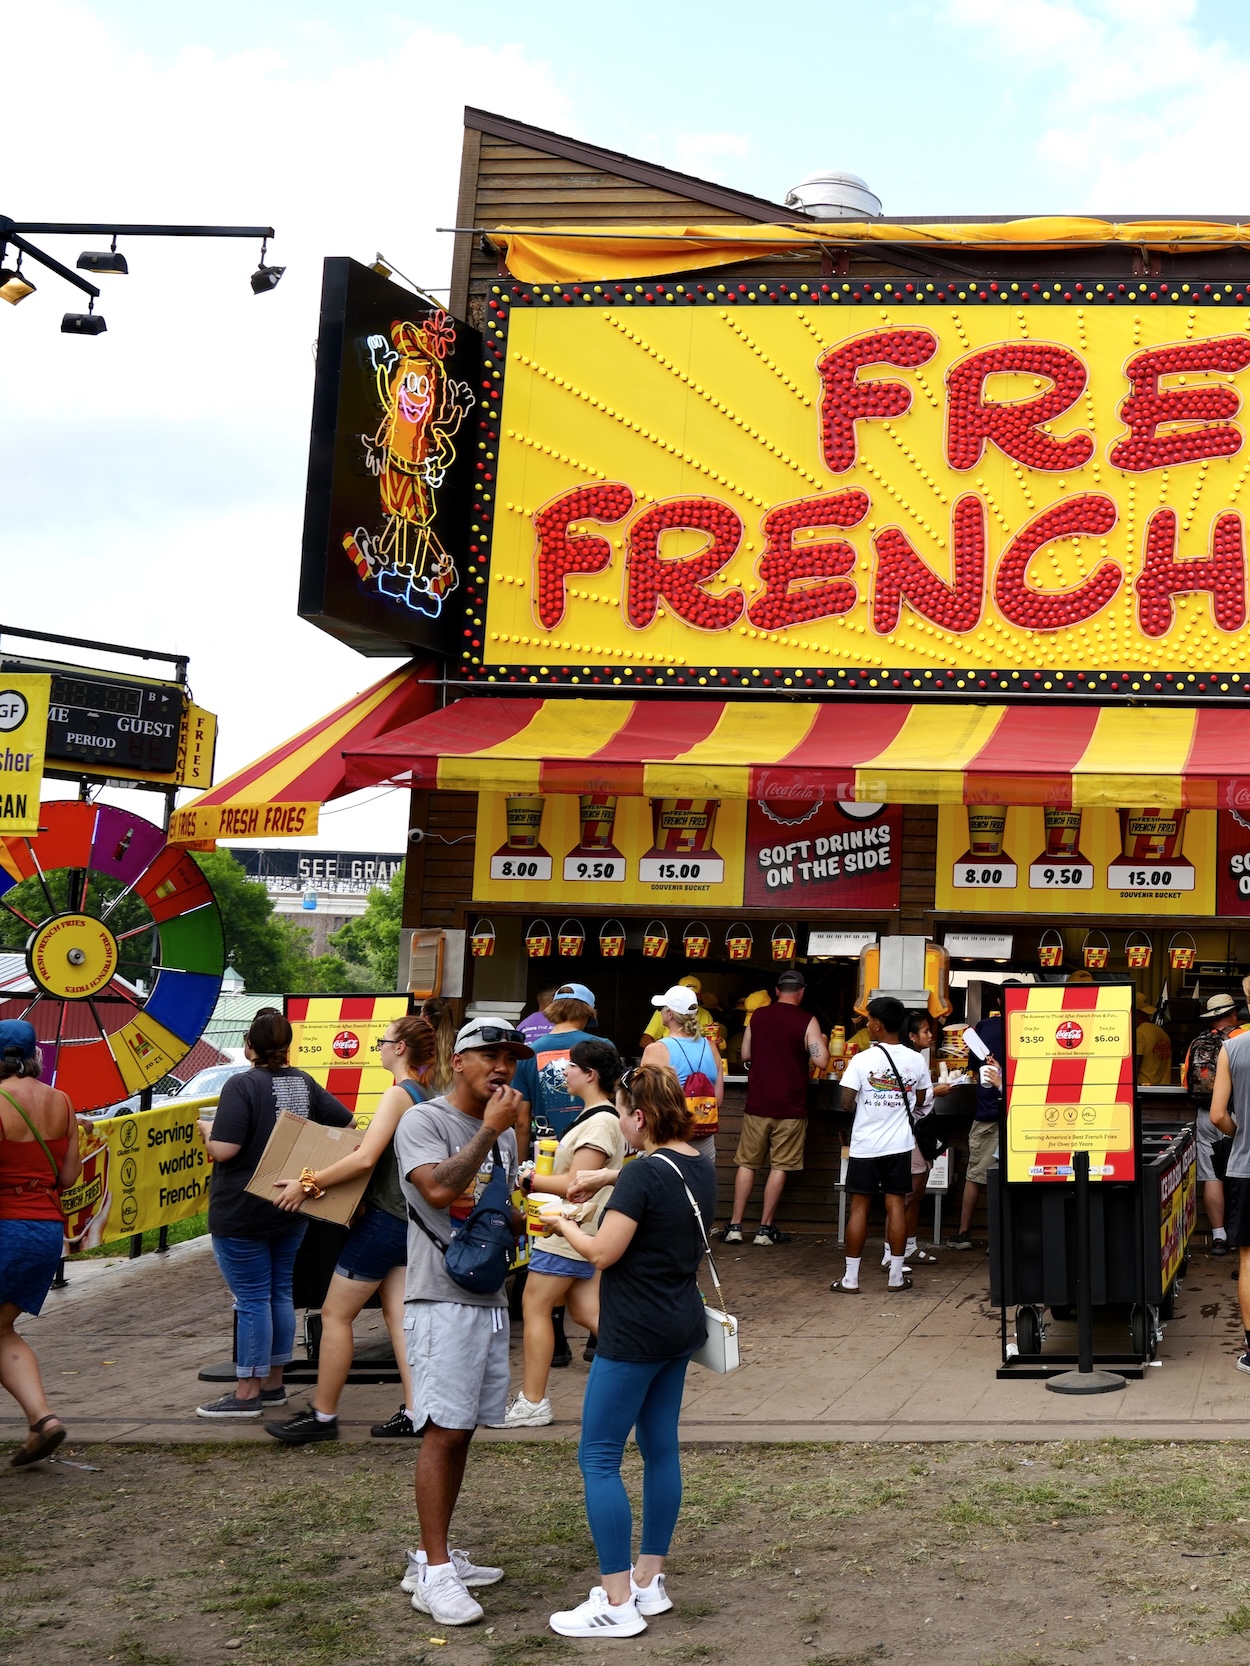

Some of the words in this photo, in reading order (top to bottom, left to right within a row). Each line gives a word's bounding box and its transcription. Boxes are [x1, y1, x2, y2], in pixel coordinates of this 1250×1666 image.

[531, 481, 1249, 640] FRENCH
[148, 692, 156, 701] B
[0, 704, 19, 718] GF
[117, 717, 174, 738] GUEST
[66, 732, 116, 749] PERIOD
[191, 717, 205, 778] FRIES
[219, 808, 259, 834] FRESH
[264, 807, 306, 832] FRIES
[663, 817, 687, 826] FRENCH
[689, 816, 706, 826] FRIES
[1131, 823, 1156, 833] FRENCH
[1157, 823, 1175, 833] FRIES
[759, 840, 811, 867] SOFT
[815, 825, 891, 856] DRINKS
[300, 858, 337, 878] SEE
[502, 862, 537, 877] 8.00
[577, 863, 614, 879] 9.50
[658, 864, 700, 879] 15.00
[767, 866, 794, 887] ON
[798, 856, 840, 880] THE
[844, 847, 891, 872] SIDE
[965, 869, 1003, 884] 8.00
[1043, 869, 1082, 884] 9.50
[1128, 871, 1172, 886] 15.00
[61, 920, 86, 928] FRIES
[38, 925, 60, 953] FRENCH
[99, 932, 112, 958] FRESH
[37, 955, 51, 981] FRESH
[90, 960, 111, 988] FRENCH
[65, 984, 89, 993] FRIES
[1056, 1030, 1082, 1040] Coca-Cola
[333, 1040, 358, 1049] Coca-Cola
[148, 1122, 193, 1148] Serving
[159, 1148, 203, 1175] world's
[159, 1176, 200, 1207] French
